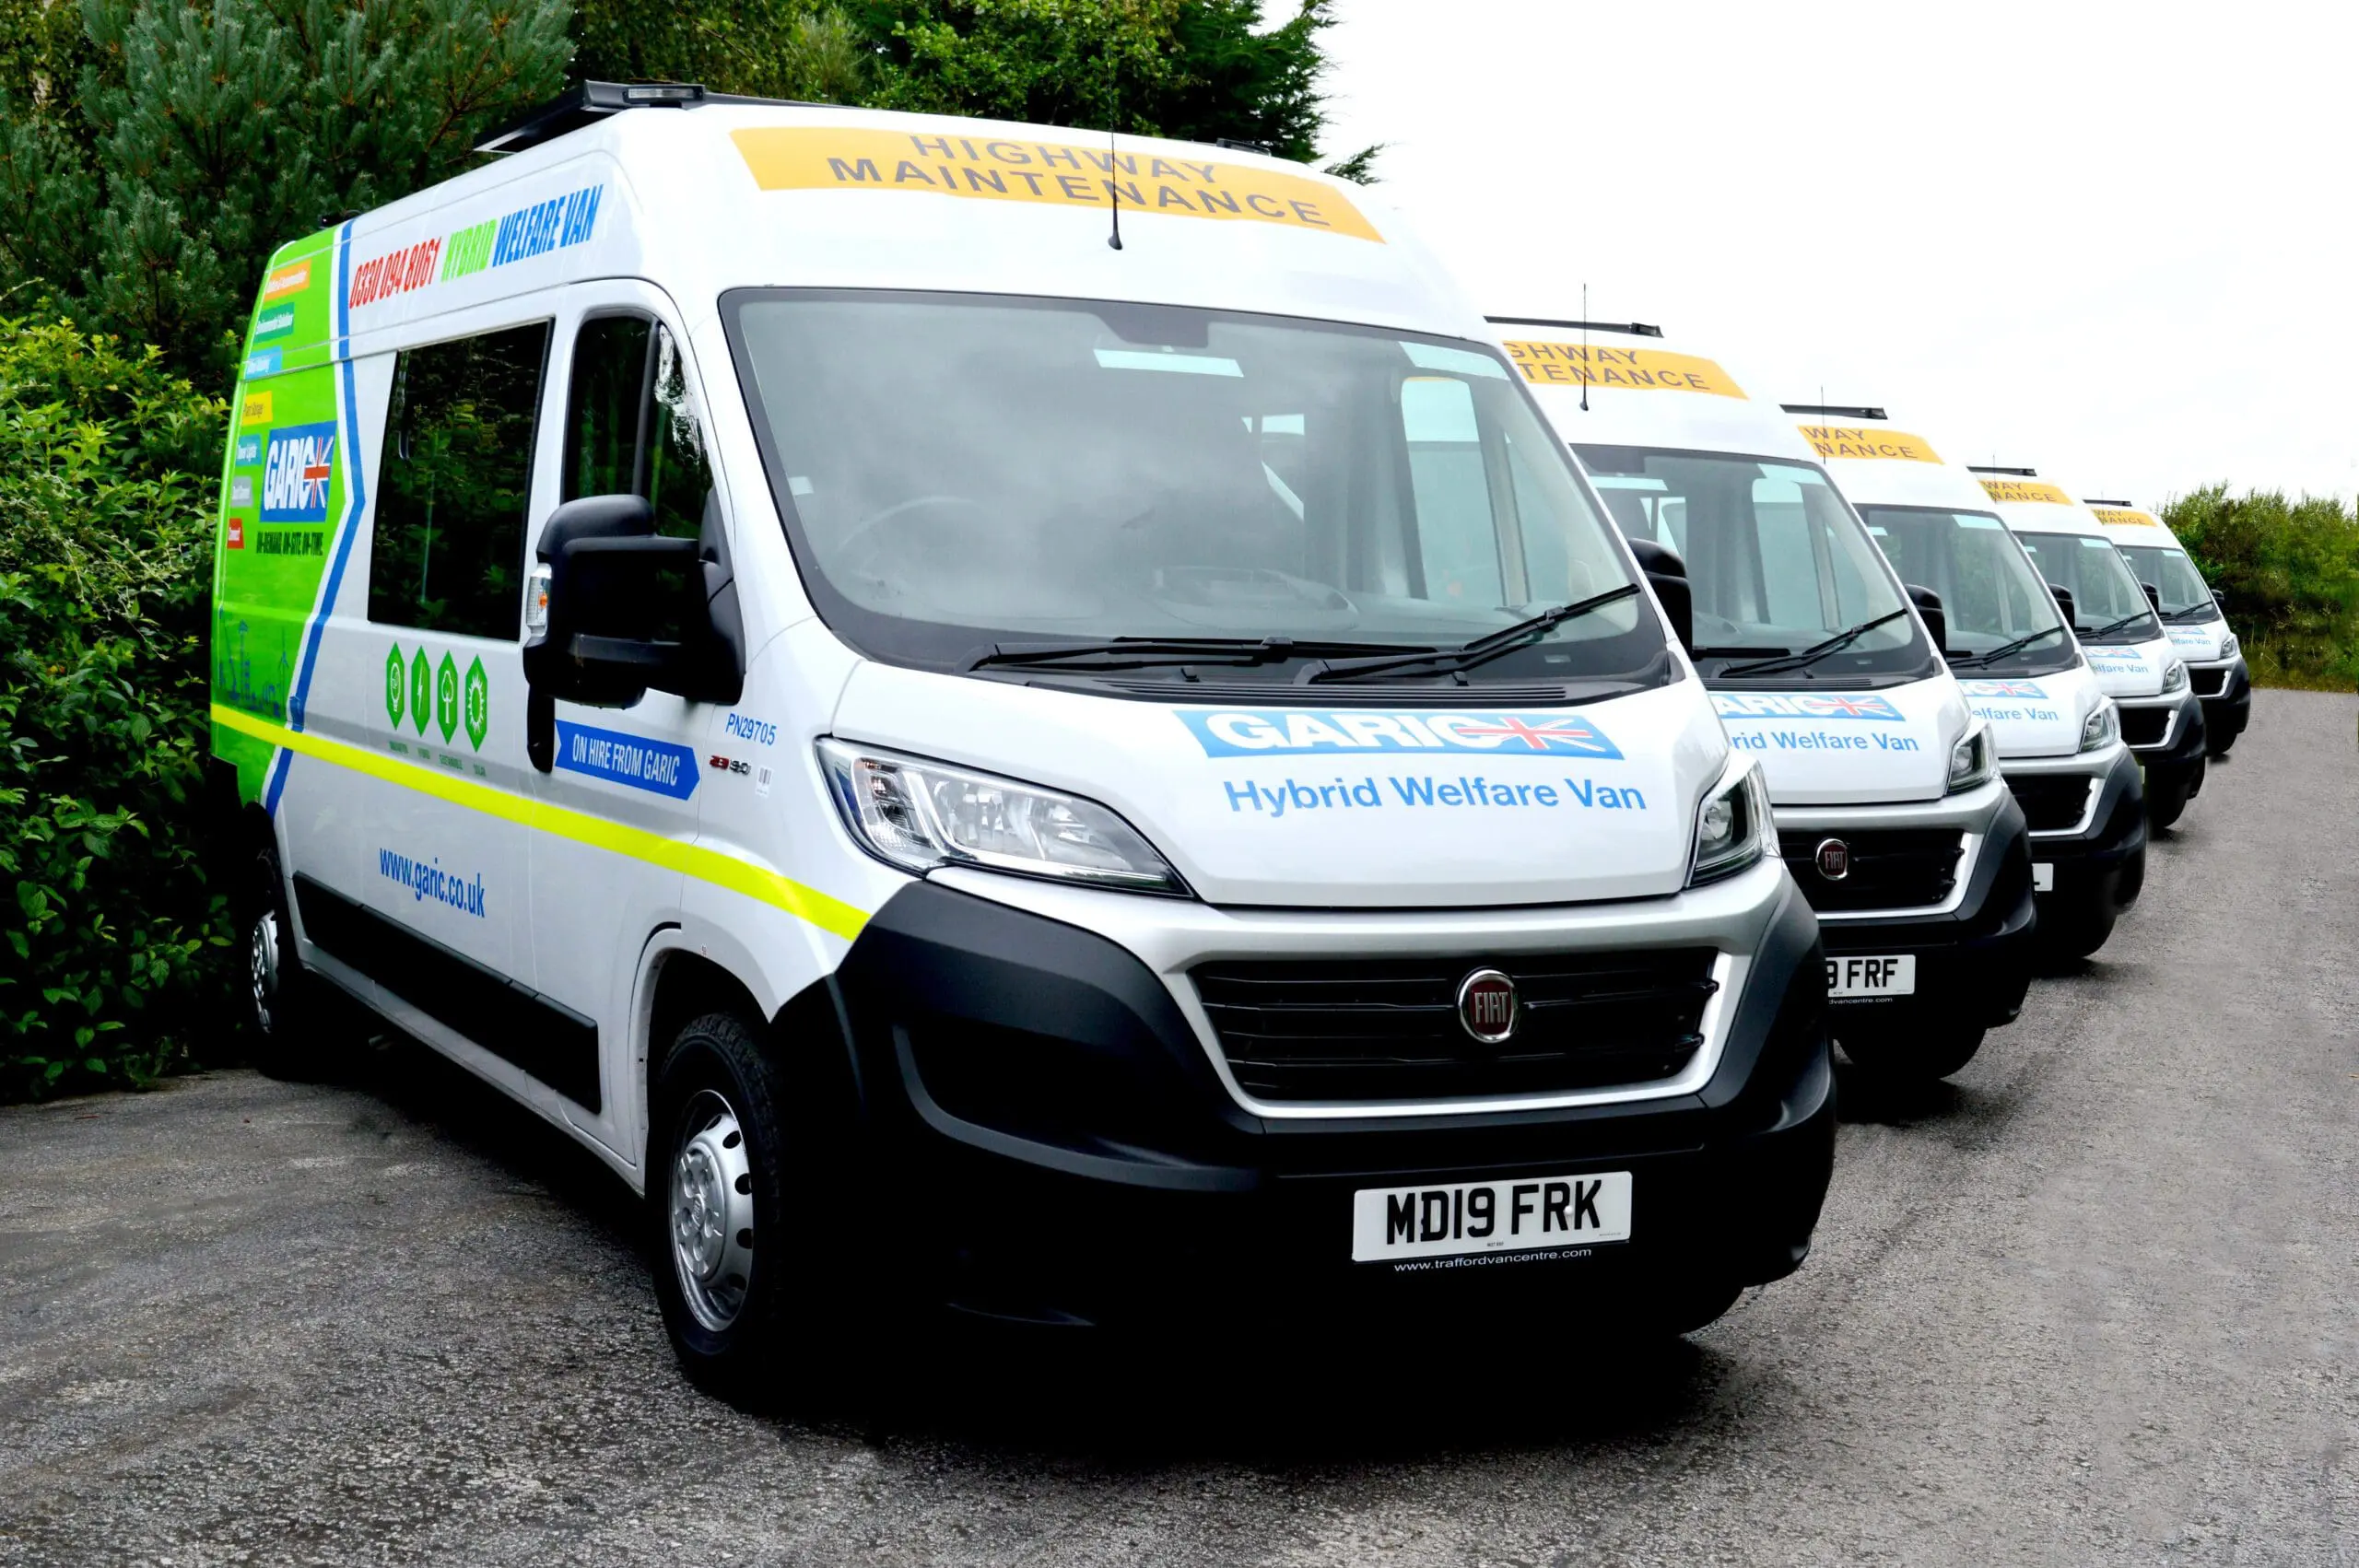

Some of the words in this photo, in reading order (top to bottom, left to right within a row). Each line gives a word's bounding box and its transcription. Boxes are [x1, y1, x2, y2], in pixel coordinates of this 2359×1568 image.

[910, 134, 1218, 184] HIGHWAY
[828, 156, 1331, 227] MAINTENANCE
[349, 256, 384, 310] 0330
[379, 248, 410, 300] 094
[403, 236, 442, 293] 8061
[440, 218, 499, 283] HYBRID
[492, 195, 567, 268] WELFARE
[559, 183, 604, 249] VAN
[1503, 342, 1637, 366] GHWAY
[1517, 363, 1711, 391] TENANCE
[264, 436, 316, 511] GARIC
[2126, 664, 2149, 673] Van
[1708, 696, 1837, 716] ARIC
[1972, 708, 2023, 720] elfare
[2024, 708, 2059, 721] Van
[725, 712, 777, 746] PN29705
[1205, 713, 1509, 751] GARIC
[1731, 731, 1767, 750] rid
[1770, 731, 1868, 750] Welfare
[1871, 732, 1920, 752] Van
[572, 733, 587, 764] ON
[588, 738, 611, 770] HIRE
[611, 742, 643, 778] FROM
[643, 749, 681, 787] GARIC
[1223, 777, 1382, 818] Hybrid
[1388, 776, 1559, 809] Welfare
[1564, 778, 1648, 810] Van
[1825, 850, 1845, 870] FIAT
[379, 847, 486, 919] www.garic.co.uk
[1847, 958, 1898, 989] FRF
[1474, 991, 1508, 1024] FIAT
[1828, 997, 1893, 1005] dvancentre.com
[1386, 1186, 1496, 1246] MD19
[1510, 1178, 1602, 1236] FRK
[1393, 1247, 1592, 1272] www.traffordvancentre.com
